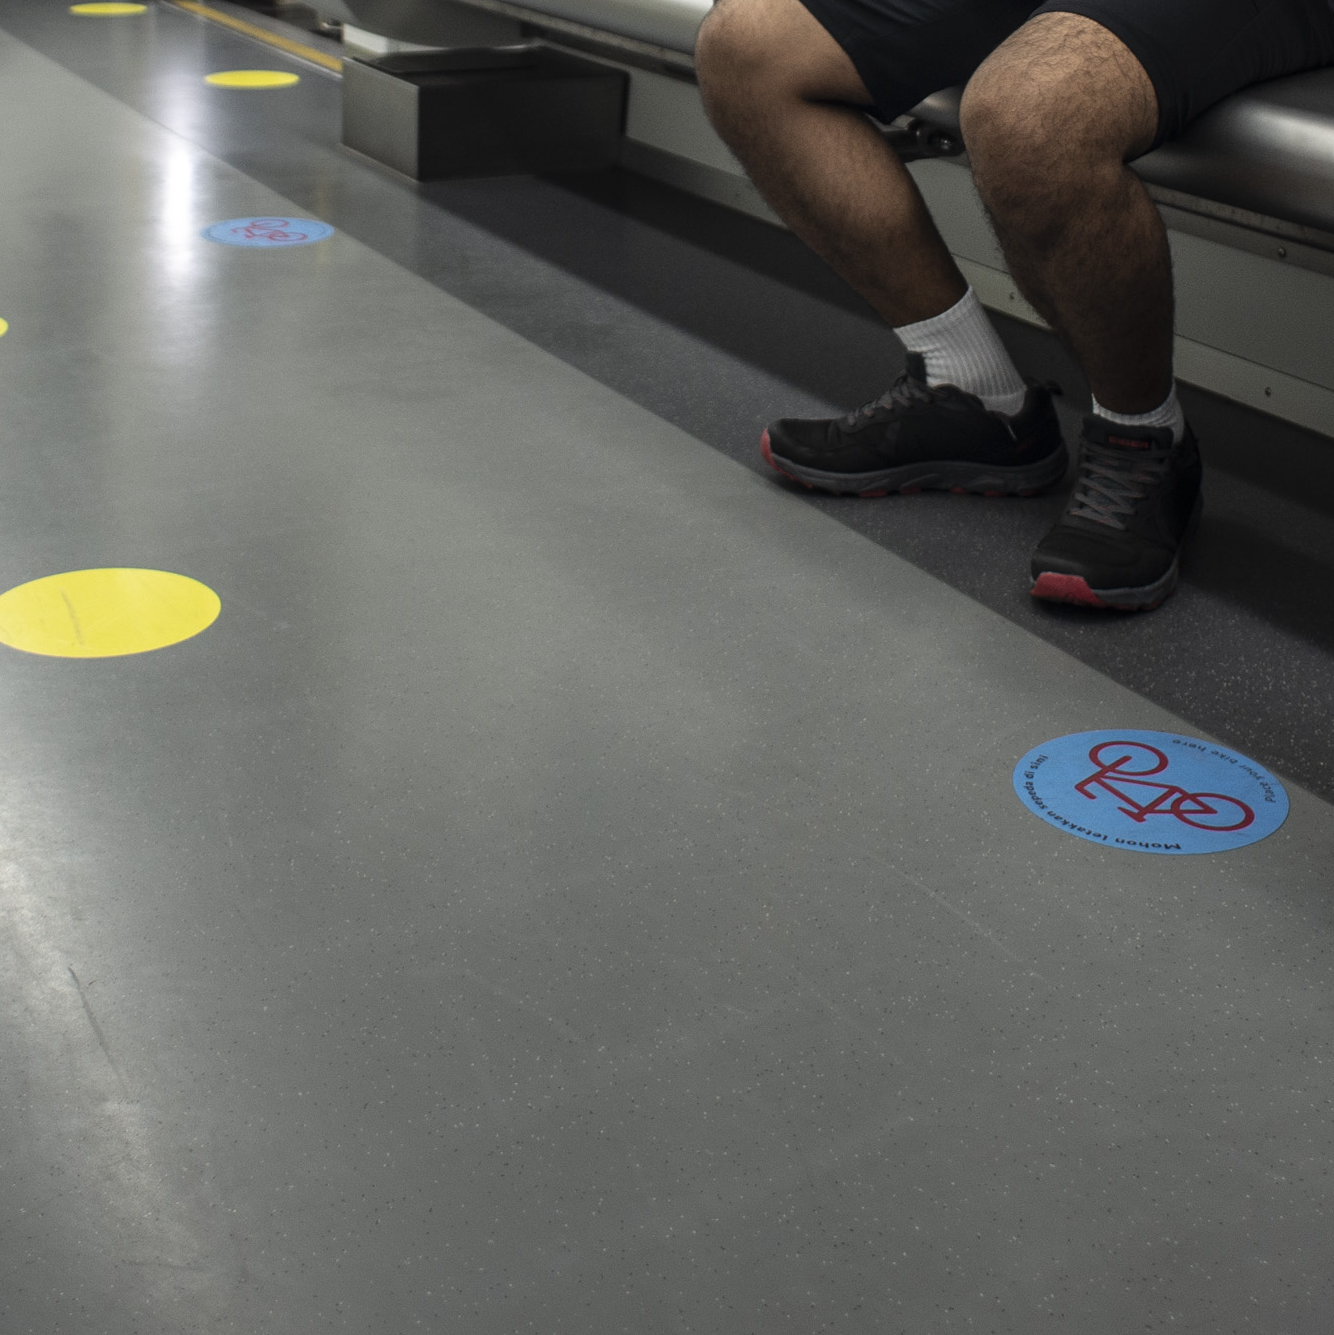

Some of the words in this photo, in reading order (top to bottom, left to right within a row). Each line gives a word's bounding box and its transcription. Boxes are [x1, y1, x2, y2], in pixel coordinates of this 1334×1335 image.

[1172, 738, 1206, 752] here
[1030, 754, 1048, 770] sini
[1211, 750, 1238, 764] bike
[1024, 770, 1035, 779] di
[1239, 765, 1265, 780] your
[1023, 781, 1047, 809] sepeda
[1047, 811, 1108, 841] letakkan
[1115, 837, 1181, 849] Mohon
